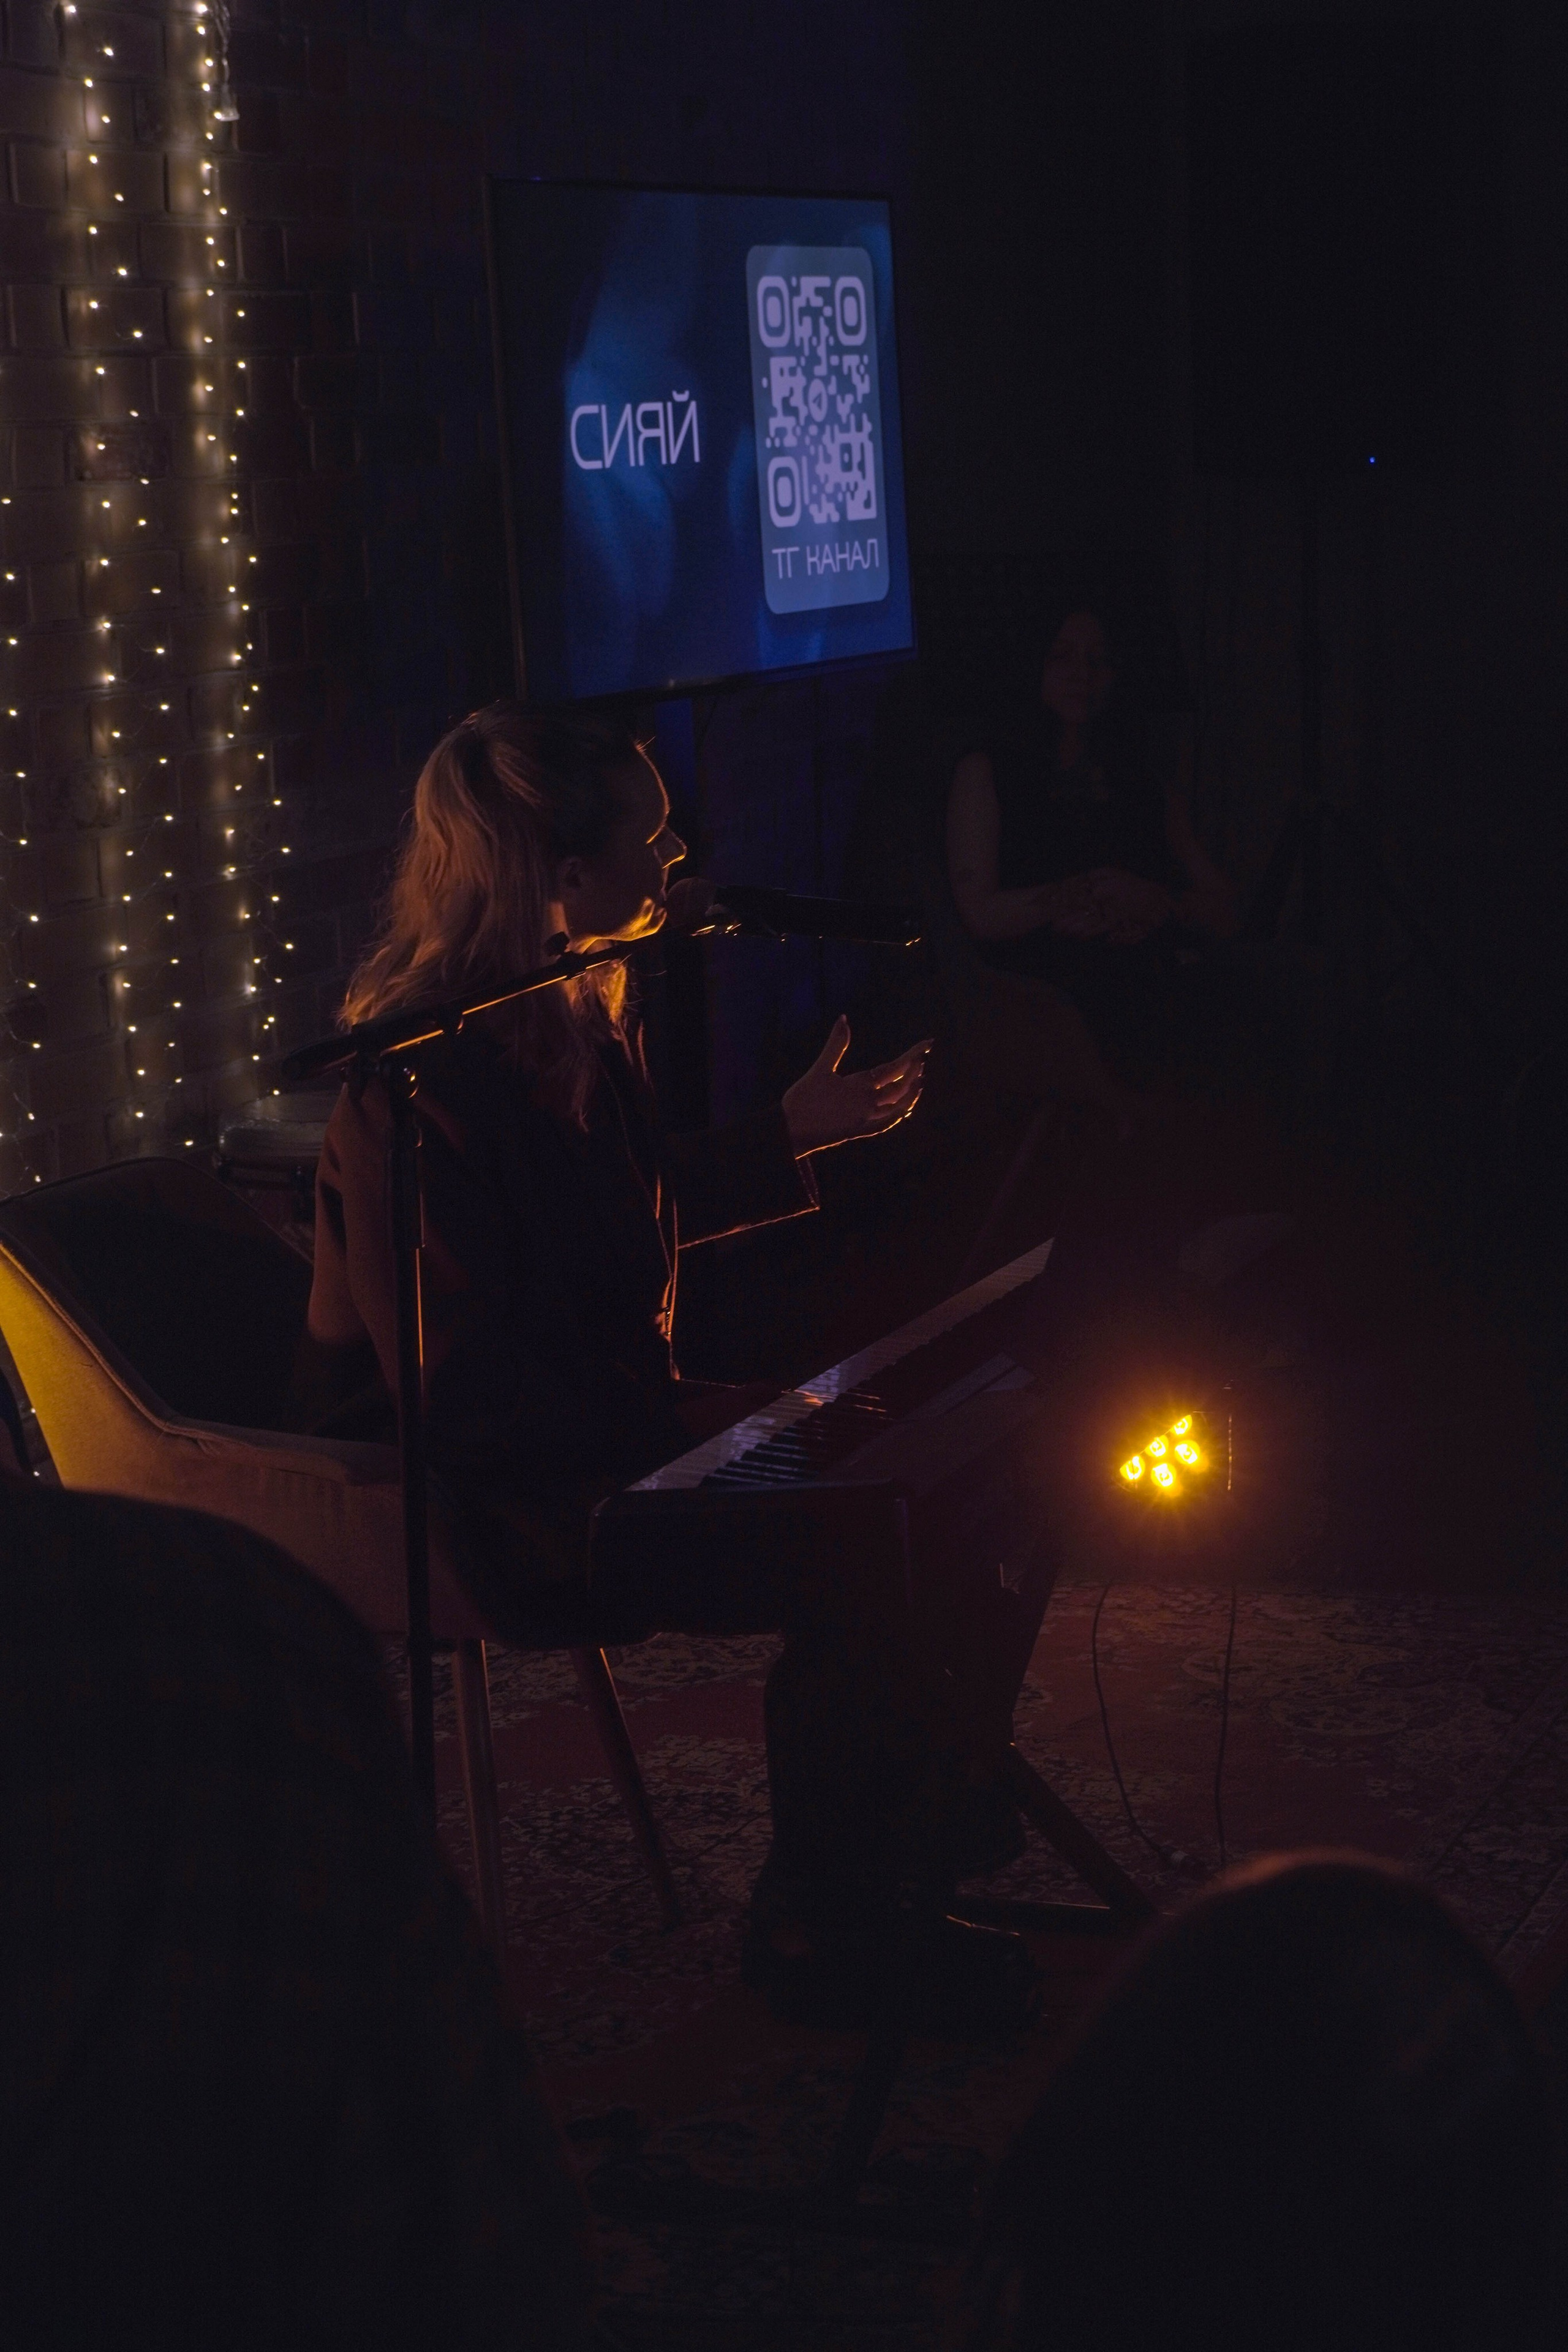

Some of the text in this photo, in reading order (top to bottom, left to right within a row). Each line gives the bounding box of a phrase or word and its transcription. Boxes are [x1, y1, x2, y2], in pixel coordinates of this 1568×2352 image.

[570, 390, 700, 470] СИЯЙ
[772, 538, 880, 579] ТГ КАНАЛ
